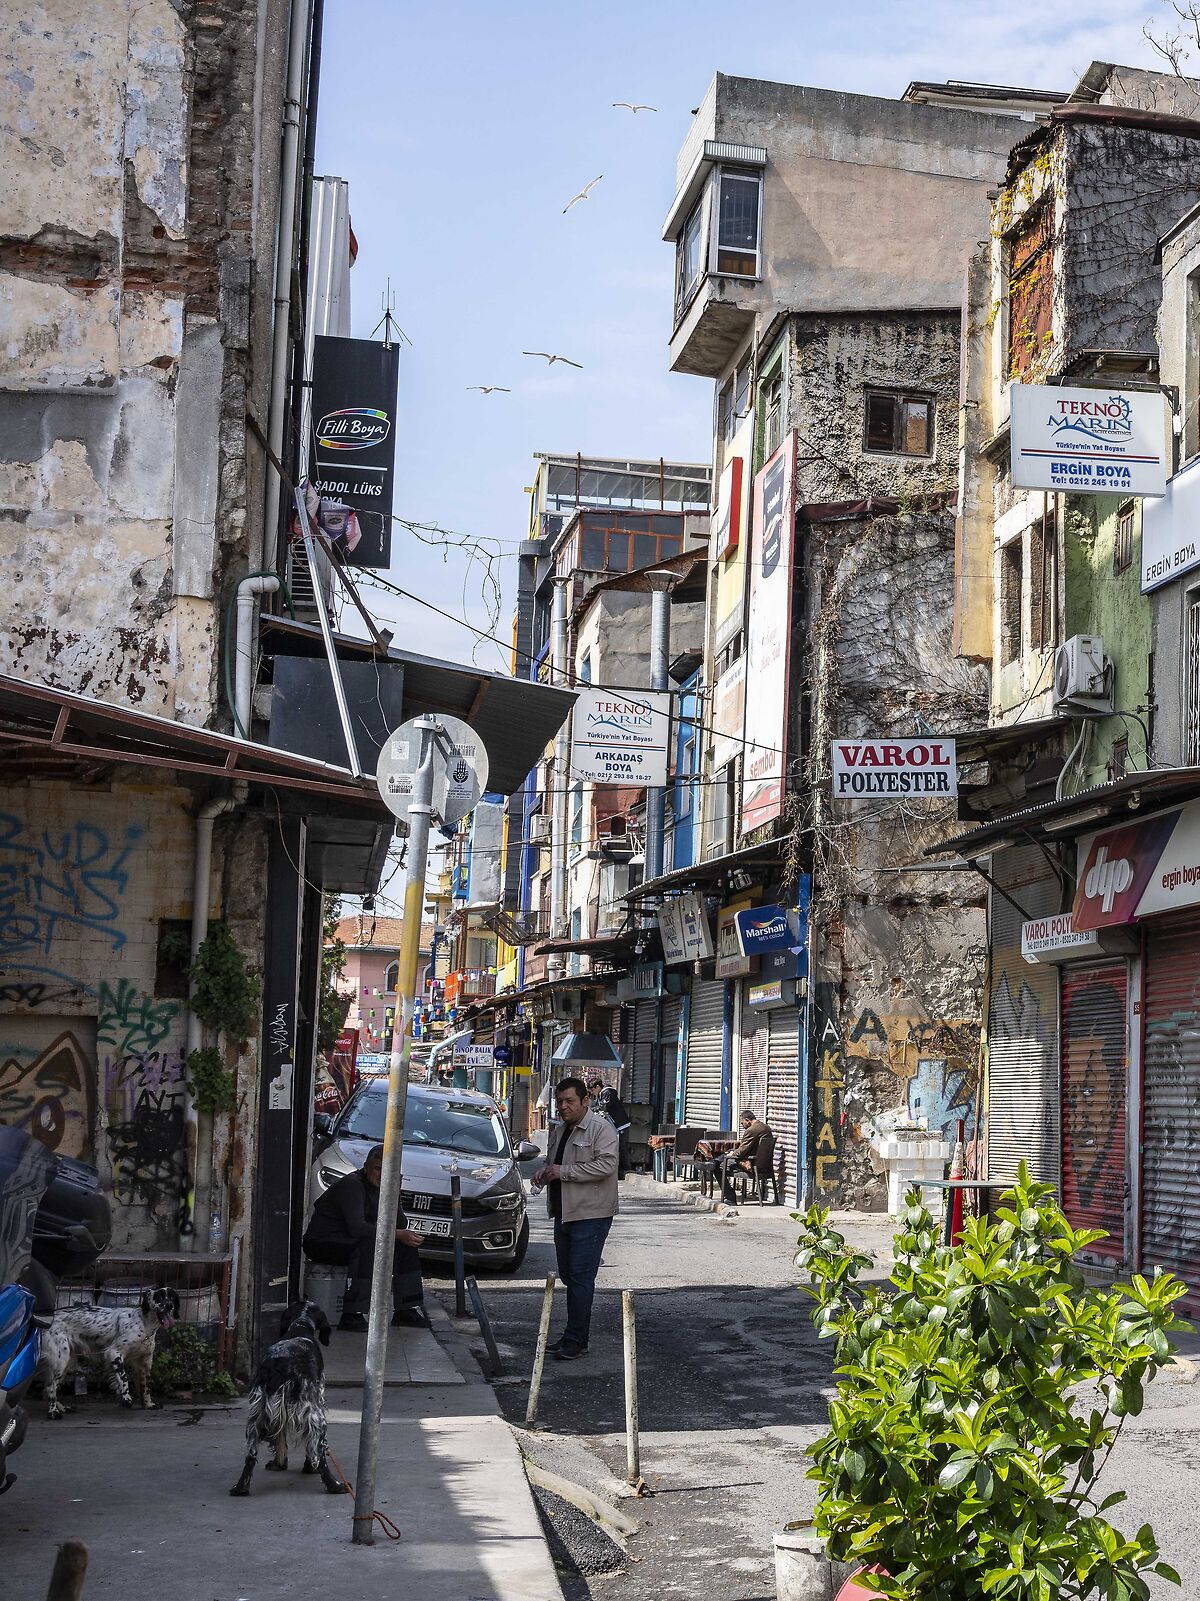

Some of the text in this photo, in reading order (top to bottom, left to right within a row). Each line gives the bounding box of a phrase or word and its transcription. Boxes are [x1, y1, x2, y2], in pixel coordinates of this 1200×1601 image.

[1057, 400, 1122, 418] TEKNO
[322, 420, 385, 439] Filli Boya
[1046, 415, 1133, 431] MARIN
[1056, 442, 1091, 453] Türkiye'nin
[1051, 461, 1132, 478] ERGİN BOYA
[353, 481, 383, 496] LÜKS
[1051, 476, 1067, 484] Tel:
[1069, 477, 1090, 485] 0212
[1092, 478, 1107, 486] 245
[1109, 479, 1119, 487] 19
[1146, 543, 1196, 582] ERGİN BOYA
[595, 701, 646, 715] TEKNO
[587, 712, 653, 726] MARIN
[587, 732, 621, 740] Türkiye'nin
[595, 752, 643, 764] ARKADAŞ
[838, 745, 951, 768] VAROL
[605, 763, 632, 773] BOYA
[838, 771, 951, 794] POLYESTER
[1085, 846, 1134, 913] dyo
[1162, 868, 1182, 891] ergin
[745, 923, 785, 939] Marshall
[1024, 922, 1050, 941] VAROL
[412, 1195, 433, 1210] FIAT
[408, 1219, 449, 1234] FZE 268
